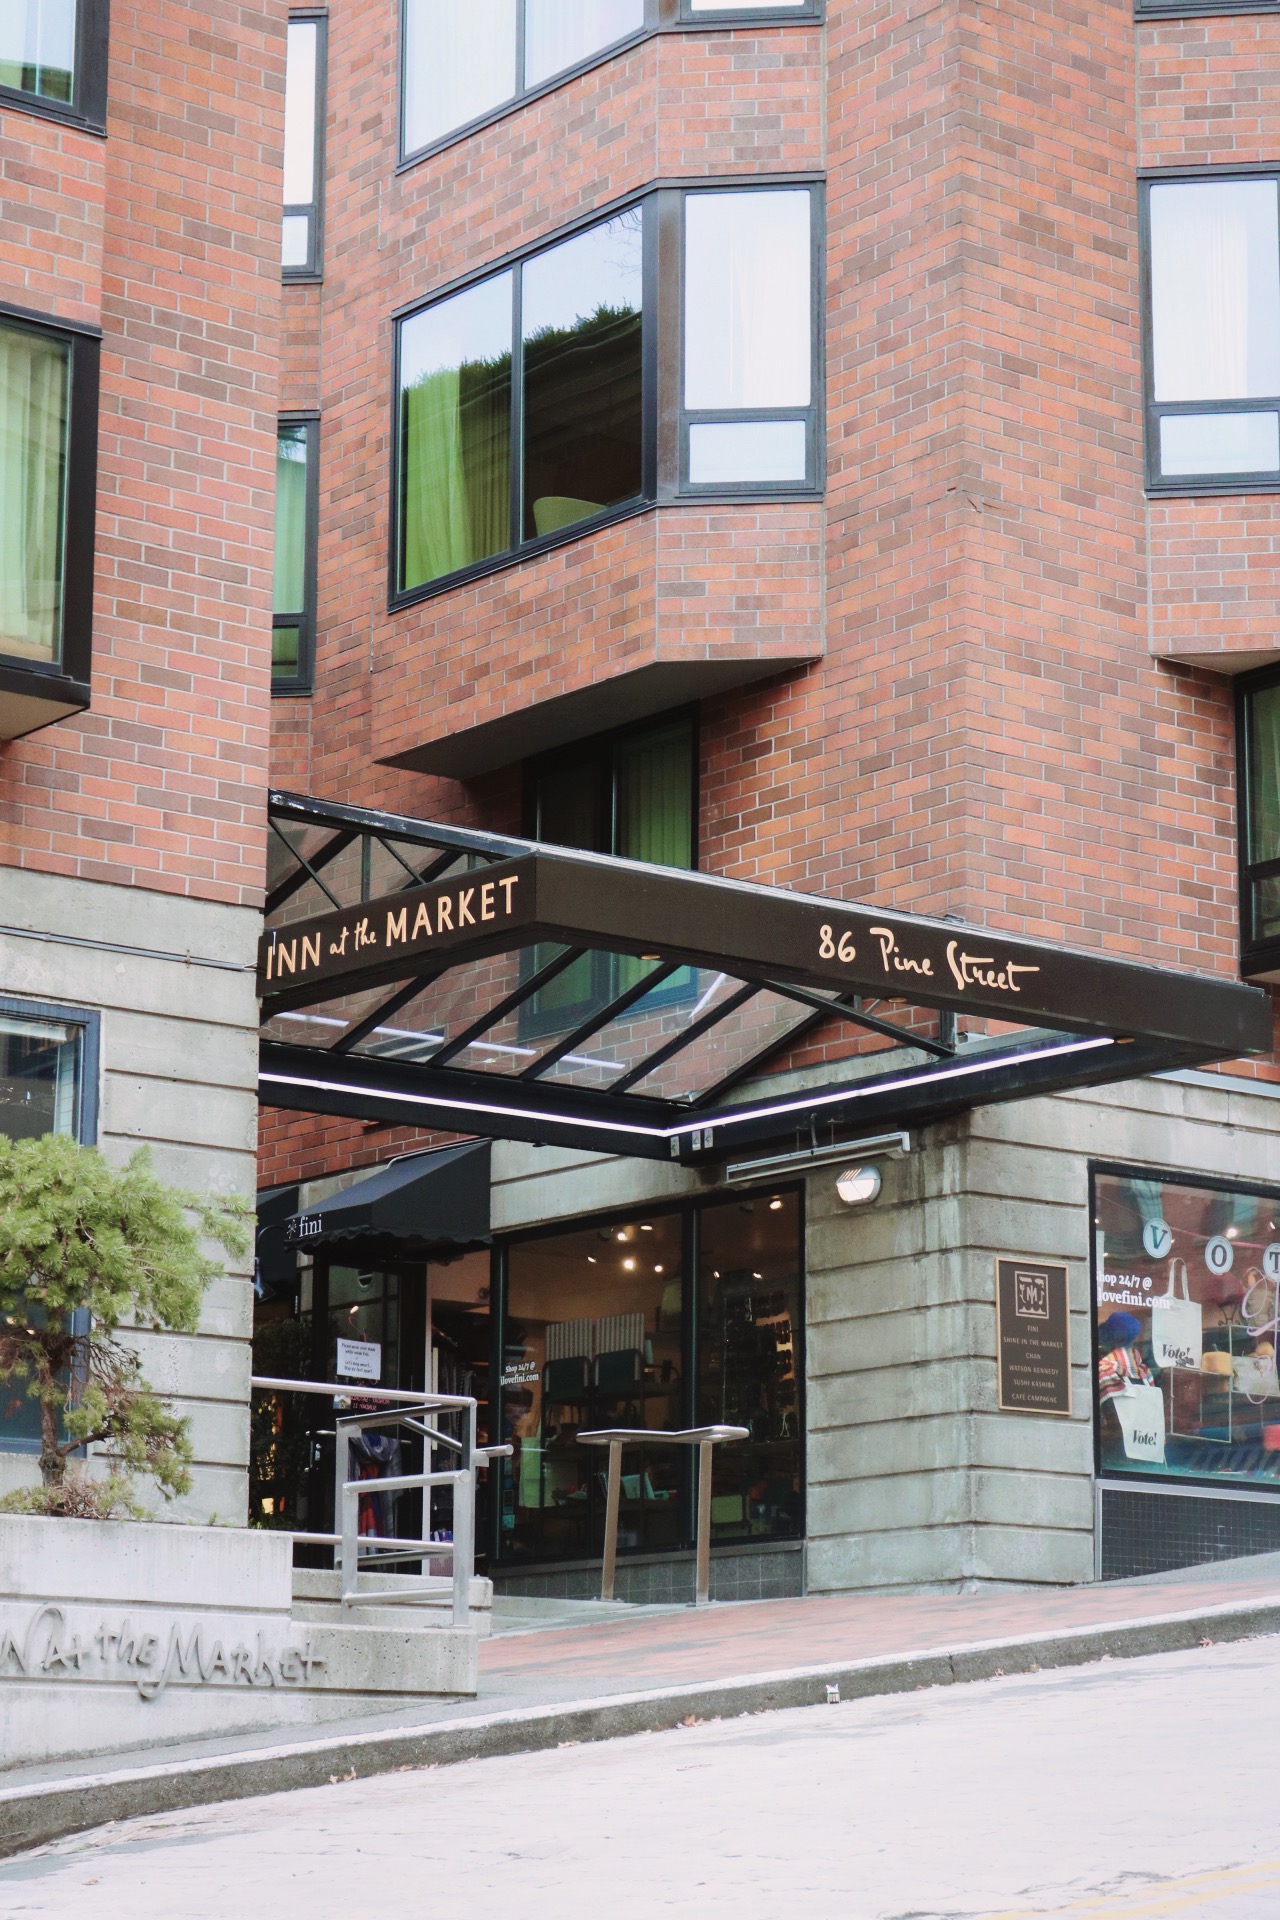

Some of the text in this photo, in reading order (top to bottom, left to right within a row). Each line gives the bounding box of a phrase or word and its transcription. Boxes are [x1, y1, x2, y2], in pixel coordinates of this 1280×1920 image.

[266, 875, 518, 980] INN at the MARKET
[818, 924, 1040, 991] 86 Pine Street
[298, 1214, 323, 1238] fini
[1118, 1274, 1140, 1288] 24/7
[1096, 1287, 1170, 1310] lovefini.com
[1041, 1340, 1063, 1349] MARKET
[1162, 1344, 1190, 1360] Vote!
[505, 1364, 517, 1374] Shop
[518, 1362, 529, 1371] 24/7
[1009, 1364, 1058, 1375] WATSON KENNEDY
[500, 1373, 539, 1386] ilovefini.com
[1132, 1430, 1157, 1446] Vote!
